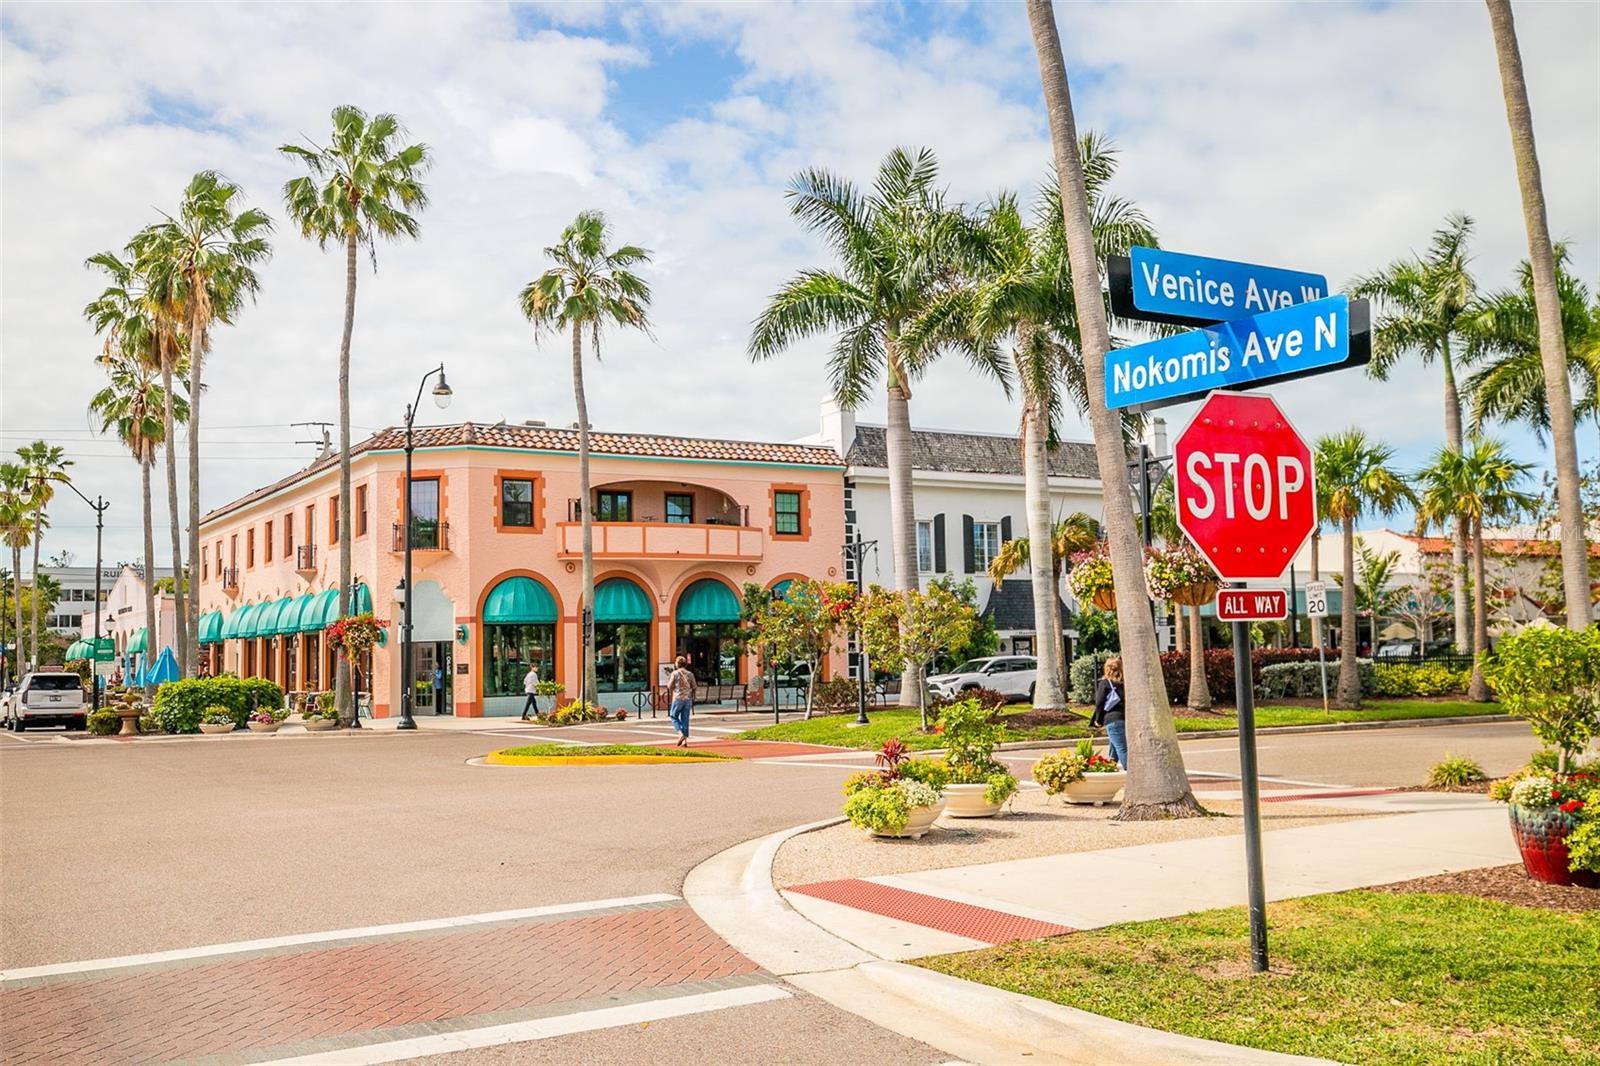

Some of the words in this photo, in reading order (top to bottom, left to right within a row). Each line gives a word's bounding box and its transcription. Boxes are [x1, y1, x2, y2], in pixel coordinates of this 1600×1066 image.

[1141, 262, 1234, 306] Venice
[1245, 278, 1293, 311] Ave
[1114, 341, 1231, 394] Nokomis
[1242, 329, 1303, 367] Ave
[1314, 312, 1337, 352] N
[1186, 451, 1304, 520] STOP
[1224, 596, 1248, 614] ALL
[1254, 595, 1281, 614] WAY
[1307, 583, 1325, 592] SPEED
[1308, 599, 1325, 614] 20
